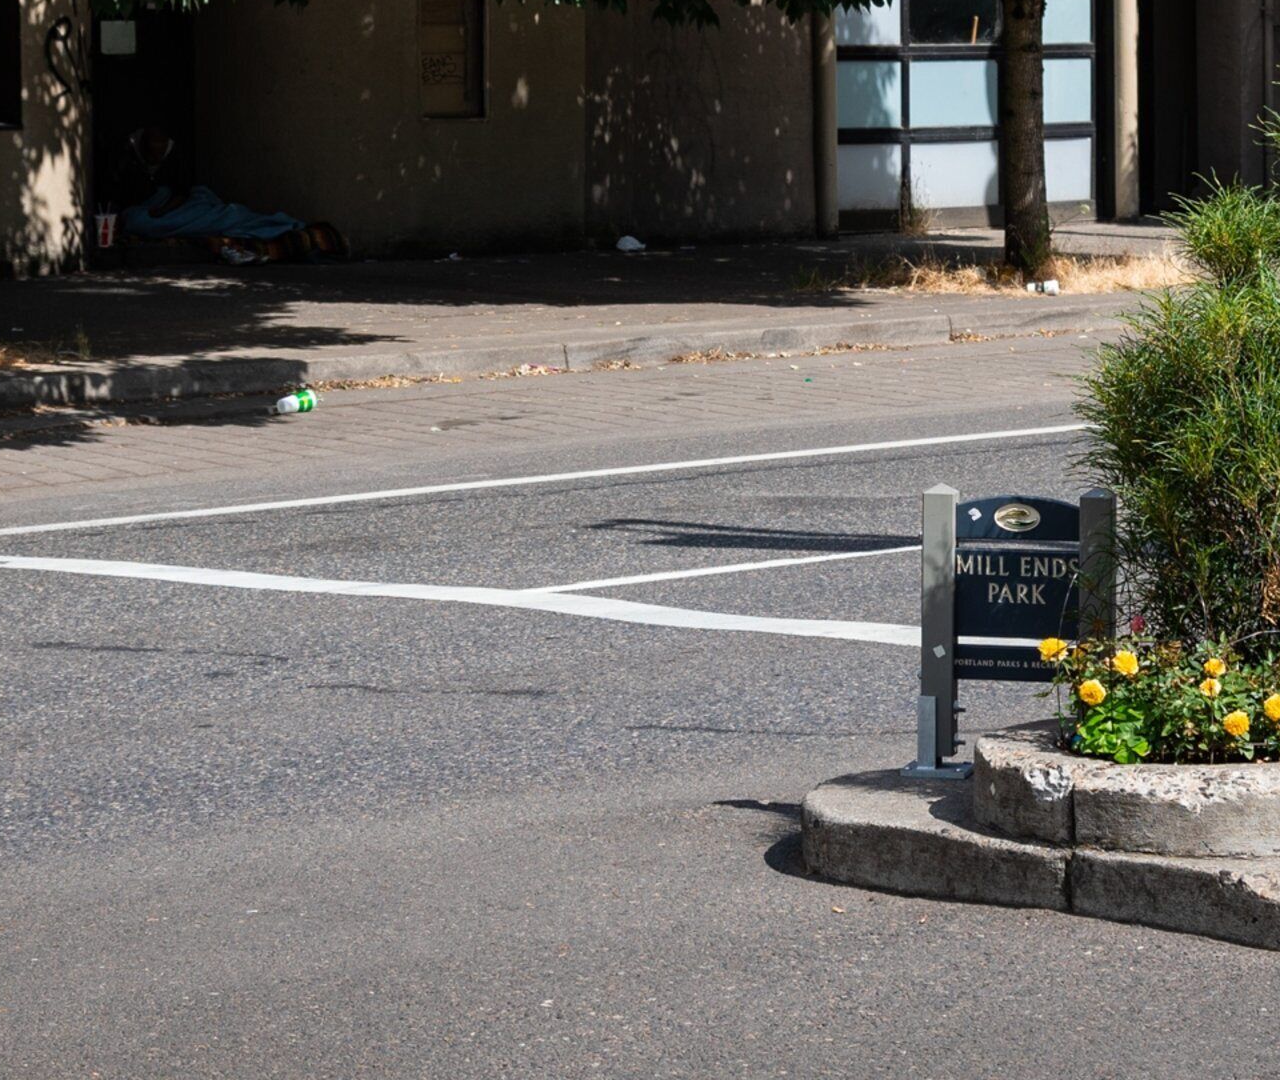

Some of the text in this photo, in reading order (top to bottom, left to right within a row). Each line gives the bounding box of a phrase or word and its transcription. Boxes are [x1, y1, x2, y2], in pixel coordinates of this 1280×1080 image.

[956, 554, 1080, 579] MILL ENDS
[988, 582, 1046, 605] PARK
[954, 658, 995, 668] PORTLAND
[997, 660, 1021, 669] PARKS
